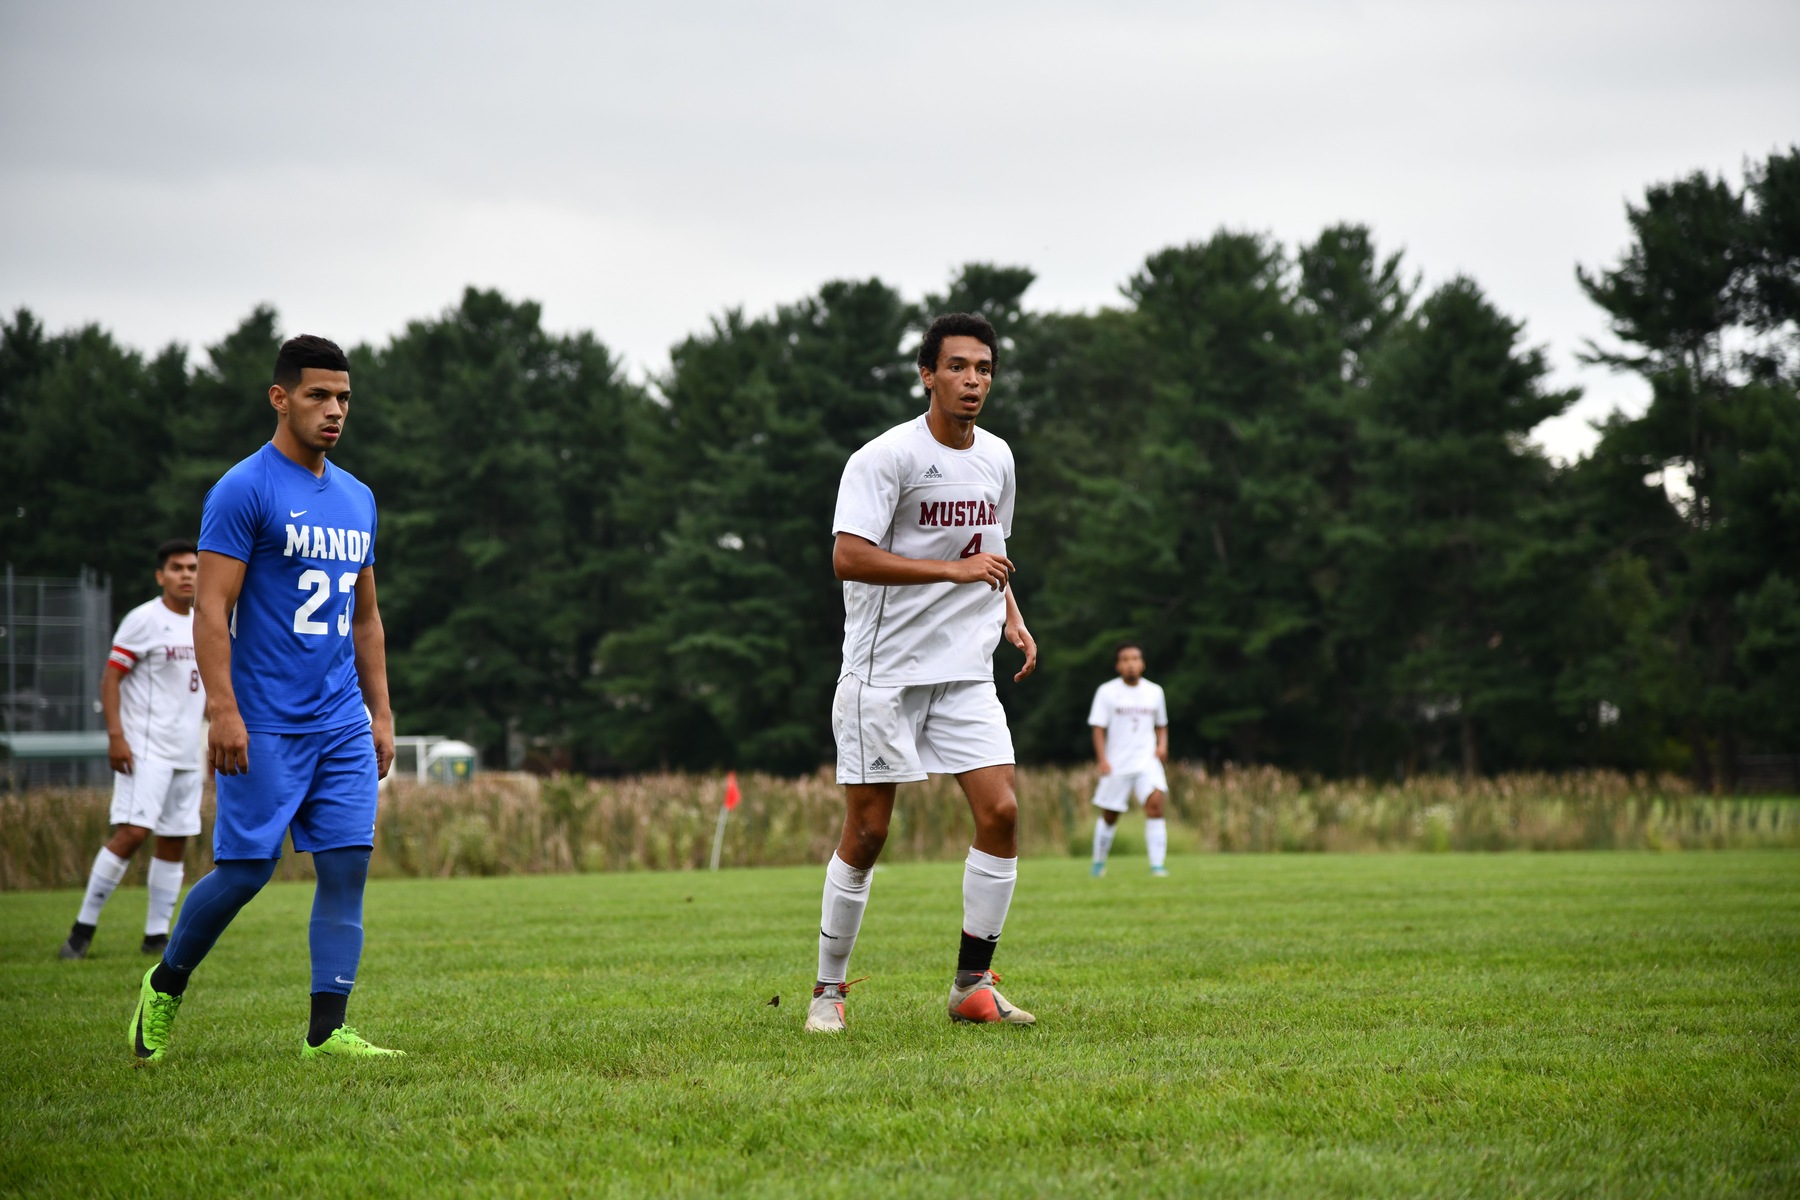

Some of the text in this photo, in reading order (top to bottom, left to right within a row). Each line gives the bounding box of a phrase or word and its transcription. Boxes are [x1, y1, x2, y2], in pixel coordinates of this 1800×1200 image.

[959, 533, 983, 559] 4
[293, 569, 359, 637] 23
[190, 669, 199, 692] 8
